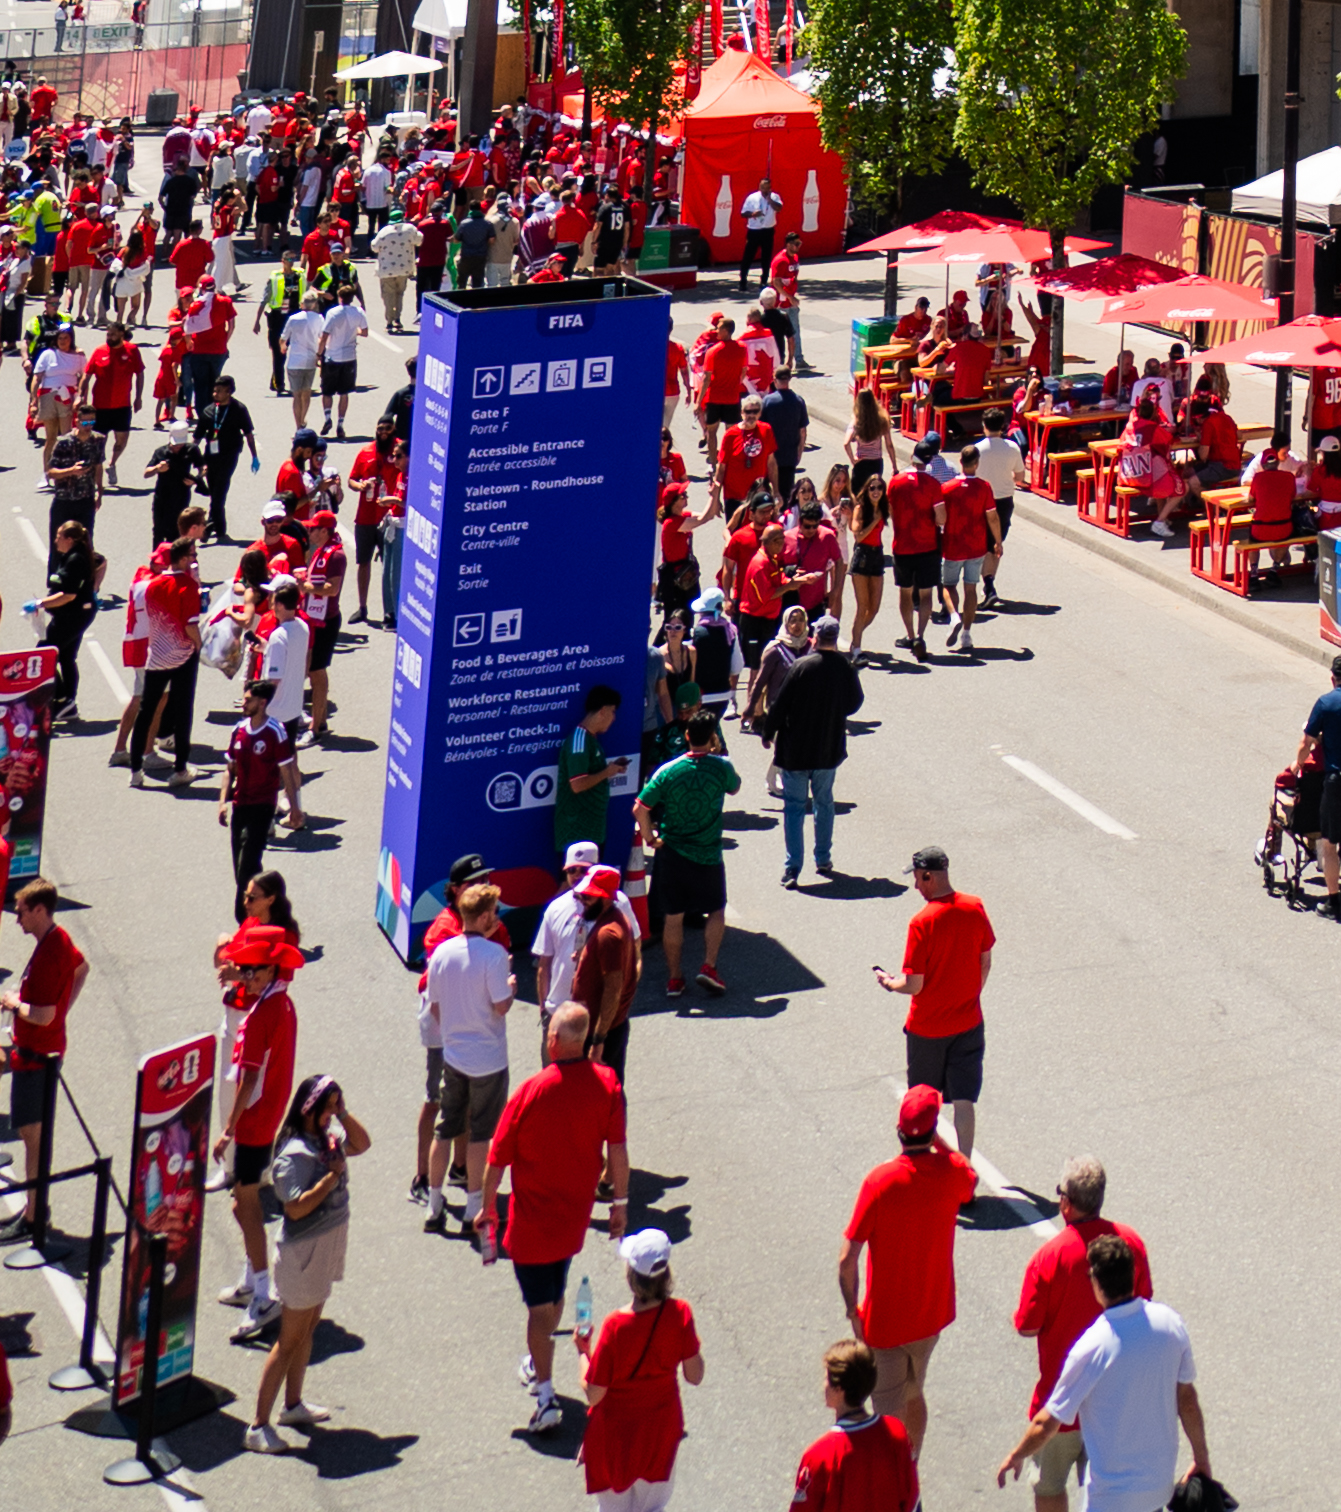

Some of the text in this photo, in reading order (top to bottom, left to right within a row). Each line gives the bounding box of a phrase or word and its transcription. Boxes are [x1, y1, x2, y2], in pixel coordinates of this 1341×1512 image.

[101, 26, 131, 38] EXIT
[753, 114, 787, 129] Coca-Cola
[610, 212, 624, 231] 19
[1167, 307, 1215, 318] Coca-Cola
[548, 314, 584, 329] FIFA
[1245, 350, 1296, 362] Coca-Cola
[471, 407, 510, 420] Gate F
[470, 421, 509, 435] Porte F
[468, 438, 585, 459] Accessible Entrance
[466, 455, 557, 474] Entrée accessible
[465, 482, 520, 497] Yaletown
[531, 474, 604, 491] Roundhouse
[463, 499, 507, 512] Station
[462, 520, 529, 537] City Centre
[461, 536, 520, 551] Centre-ville
[458, 563, 482, 575] Exit
[457, 577, 489, 590] Sortie
[451, 642, 590, 670] Food & Beverages Area
[449, 652, 625, 686] Zone de restauration et boissons
[448, 683, 581, 708] Workforce Restaurant
[447, 708, 501, 724] Personnel
[510, 698, 569, 717] Restaurant
[445, 722, 561, 747] Volunteer Check-In
[444, 745, 498, 764] Bénévoles
